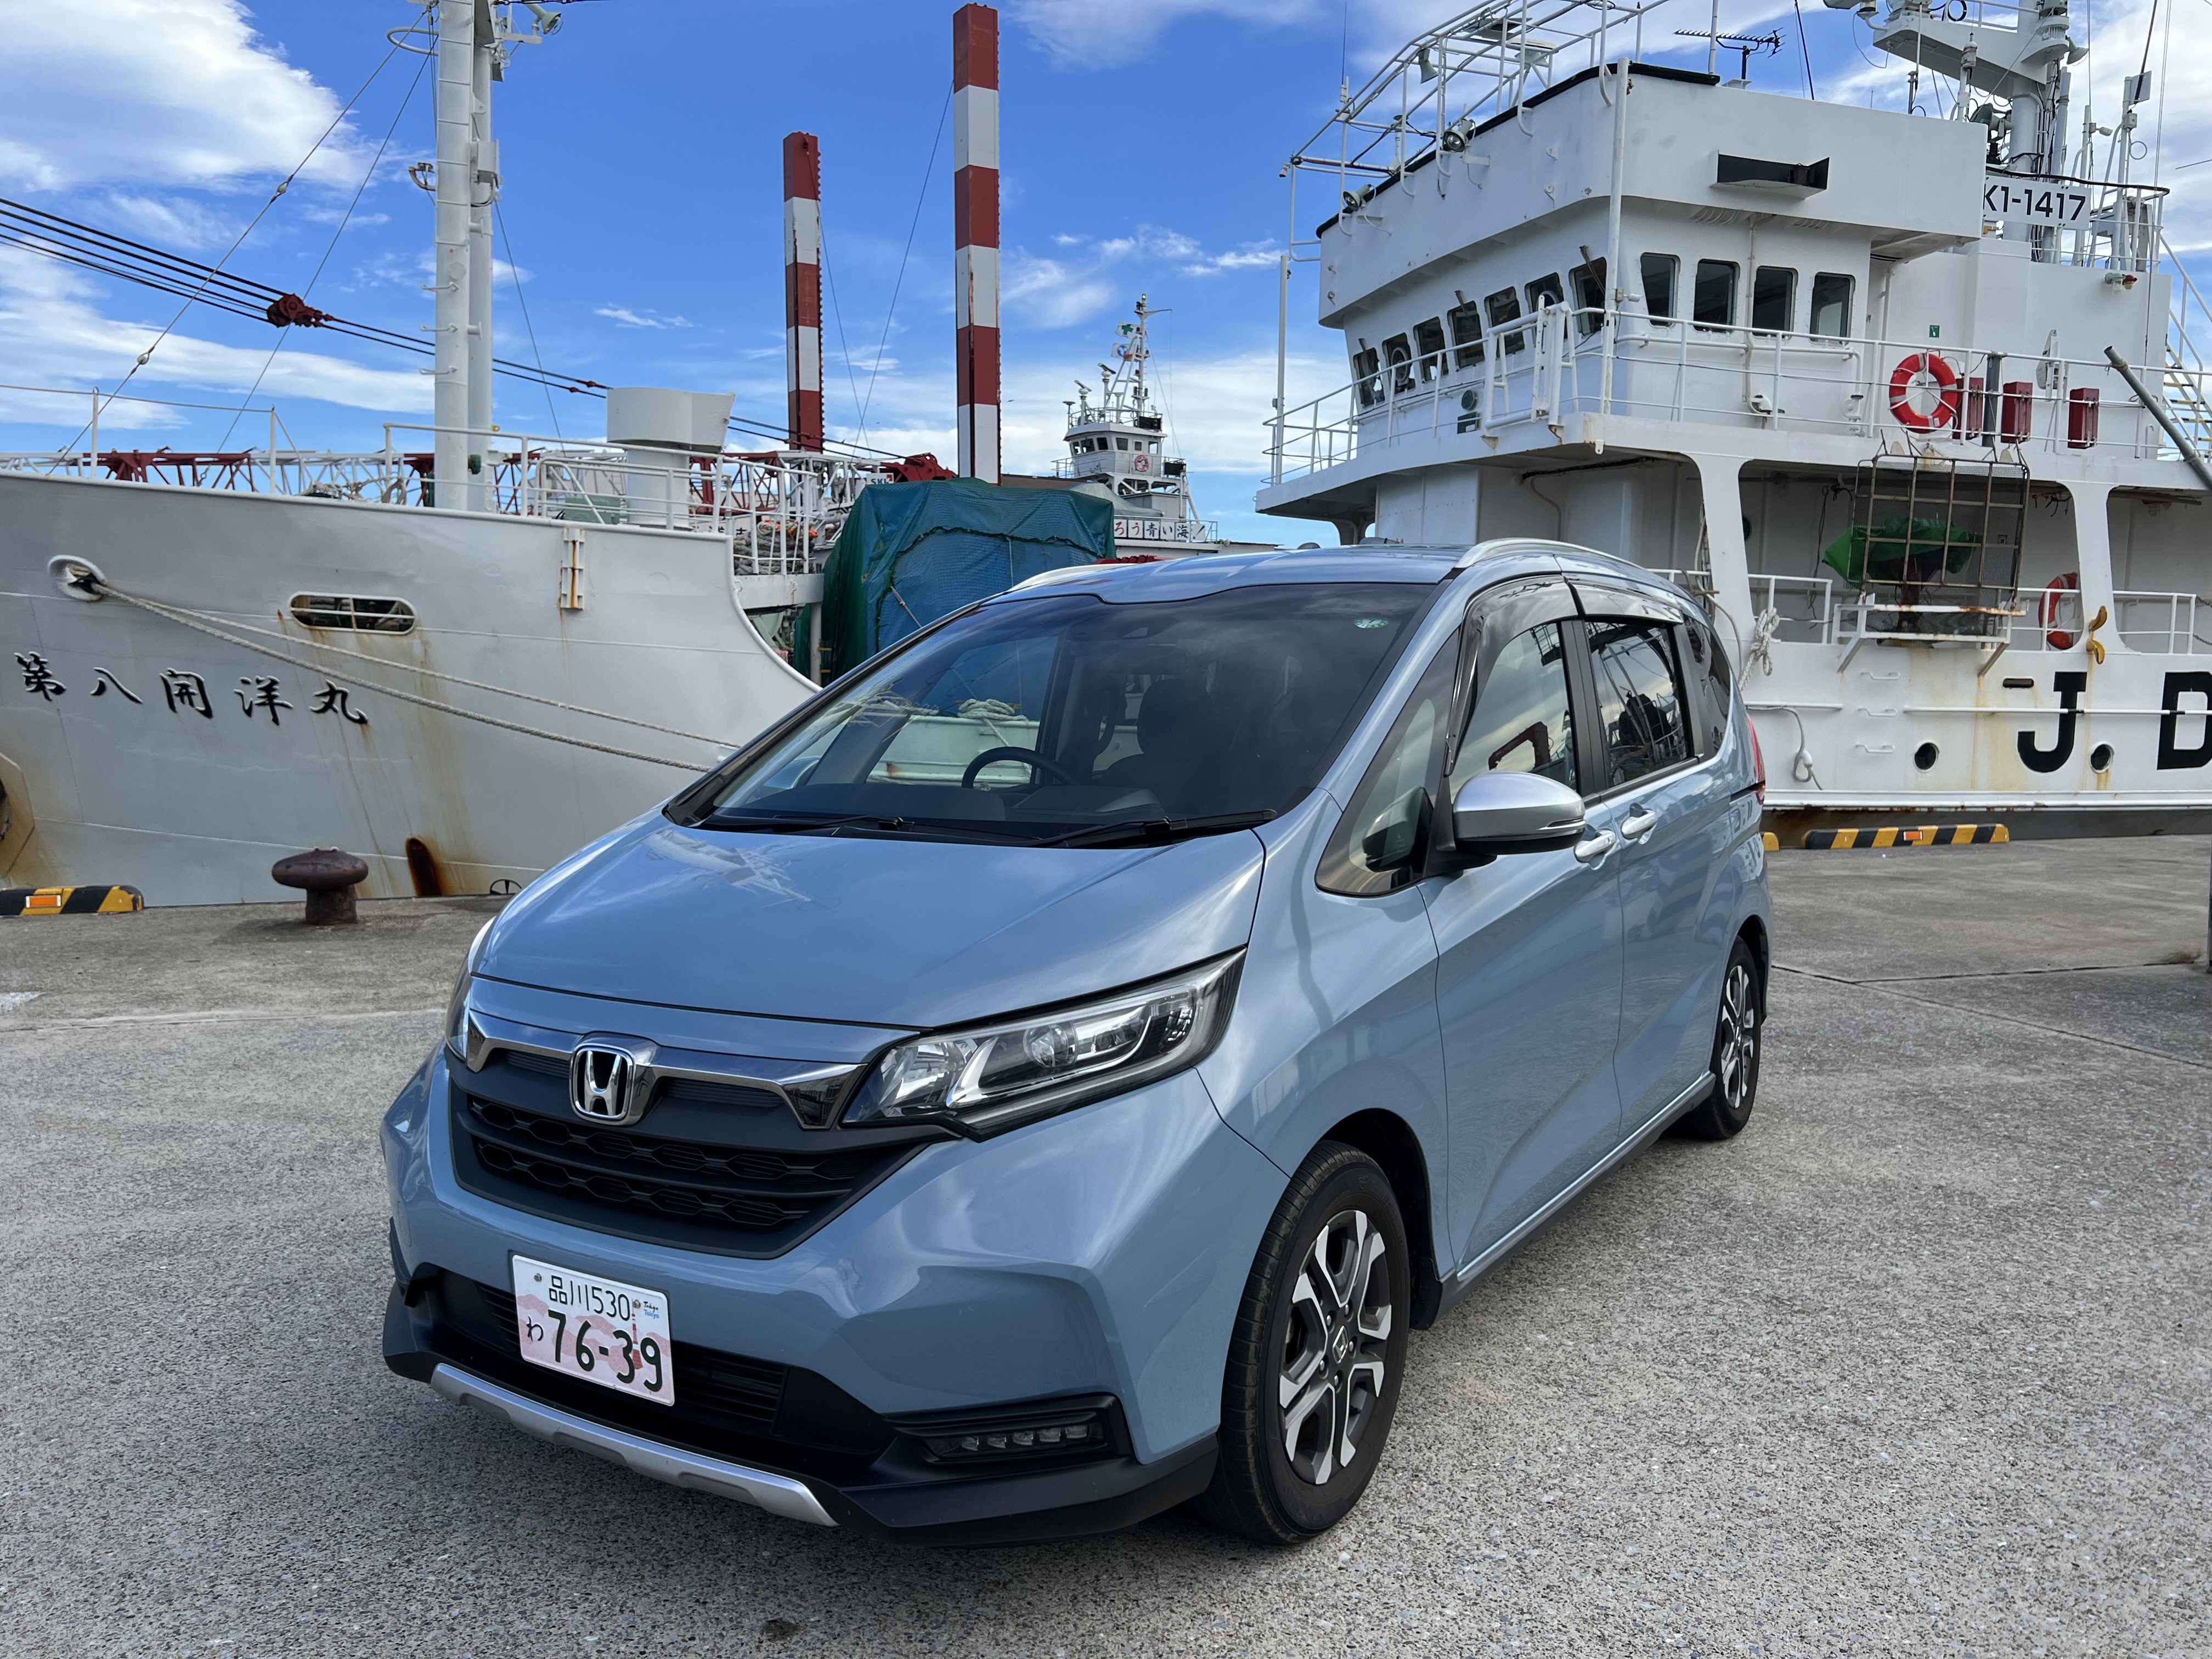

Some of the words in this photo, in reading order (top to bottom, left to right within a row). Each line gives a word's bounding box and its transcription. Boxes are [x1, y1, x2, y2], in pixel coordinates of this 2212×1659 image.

[1983, 183, 2086, 221] K1-1417
[527, 1316, 544, 1342] わ
[549, 1309, 663, 1392] 76-39
